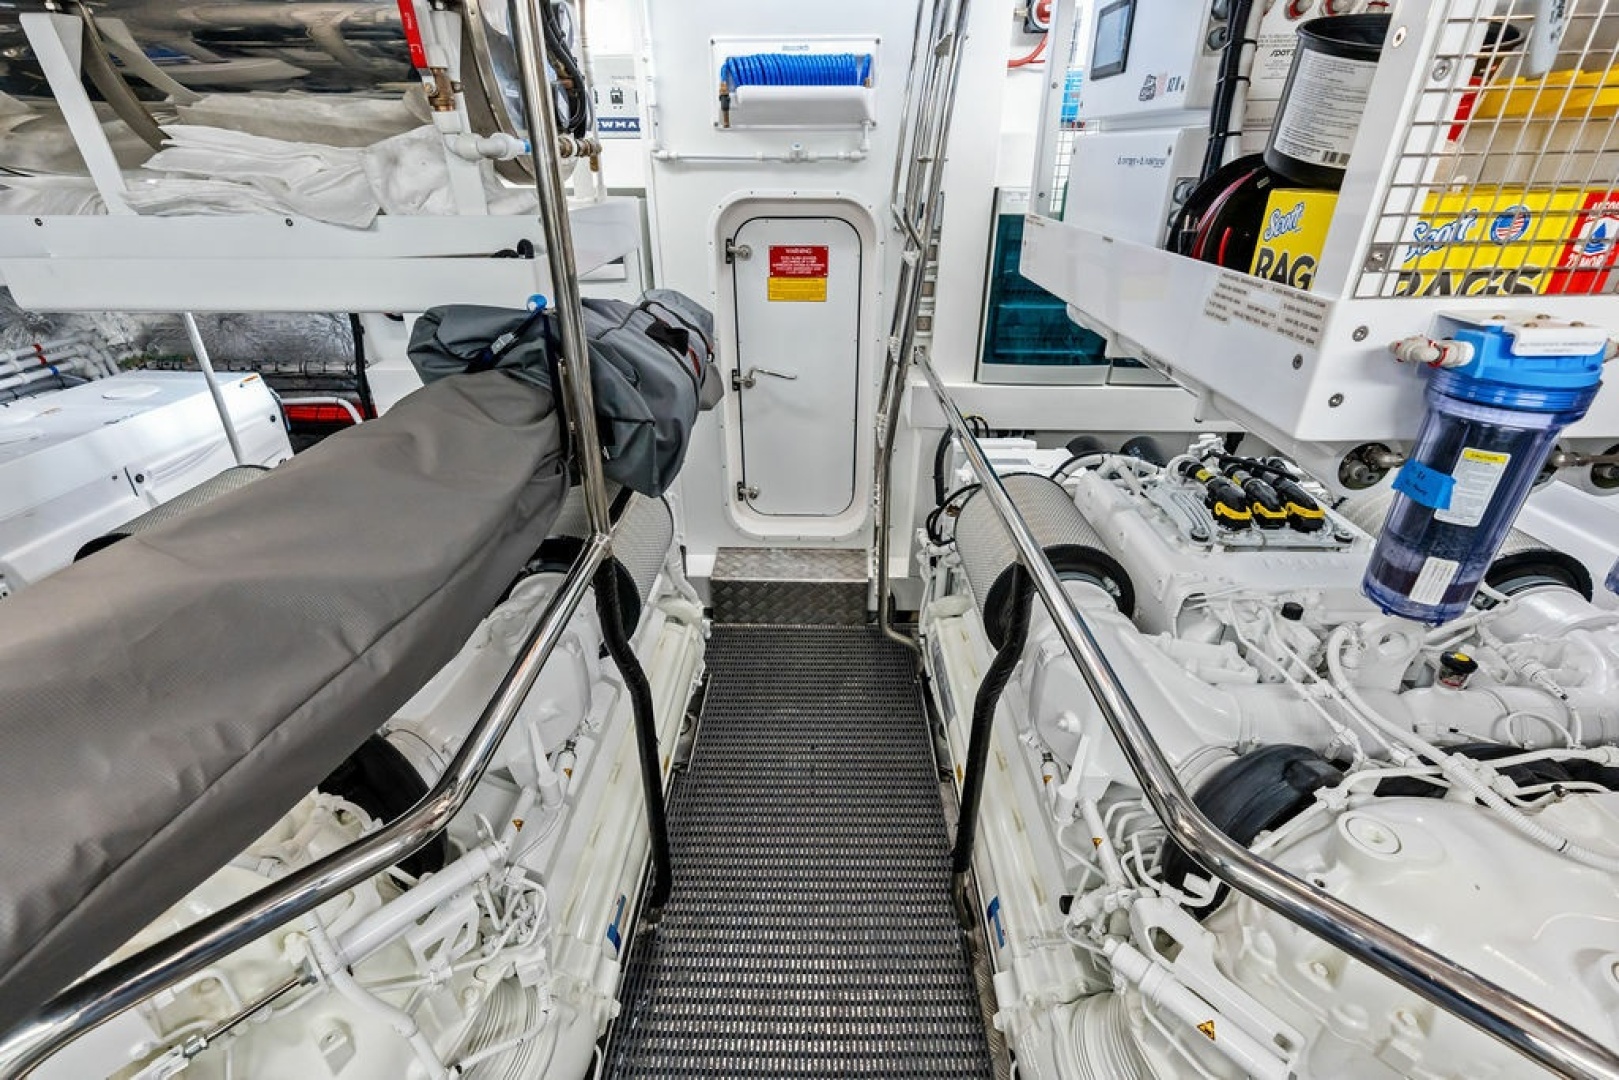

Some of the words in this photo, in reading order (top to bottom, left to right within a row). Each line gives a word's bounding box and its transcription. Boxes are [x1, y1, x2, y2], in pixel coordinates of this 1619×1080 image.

[1263, 202, 1304, 242] Scott
[1404, 208, 1478, 263] Scott
[1255, 247, 1318, 290] RAG
